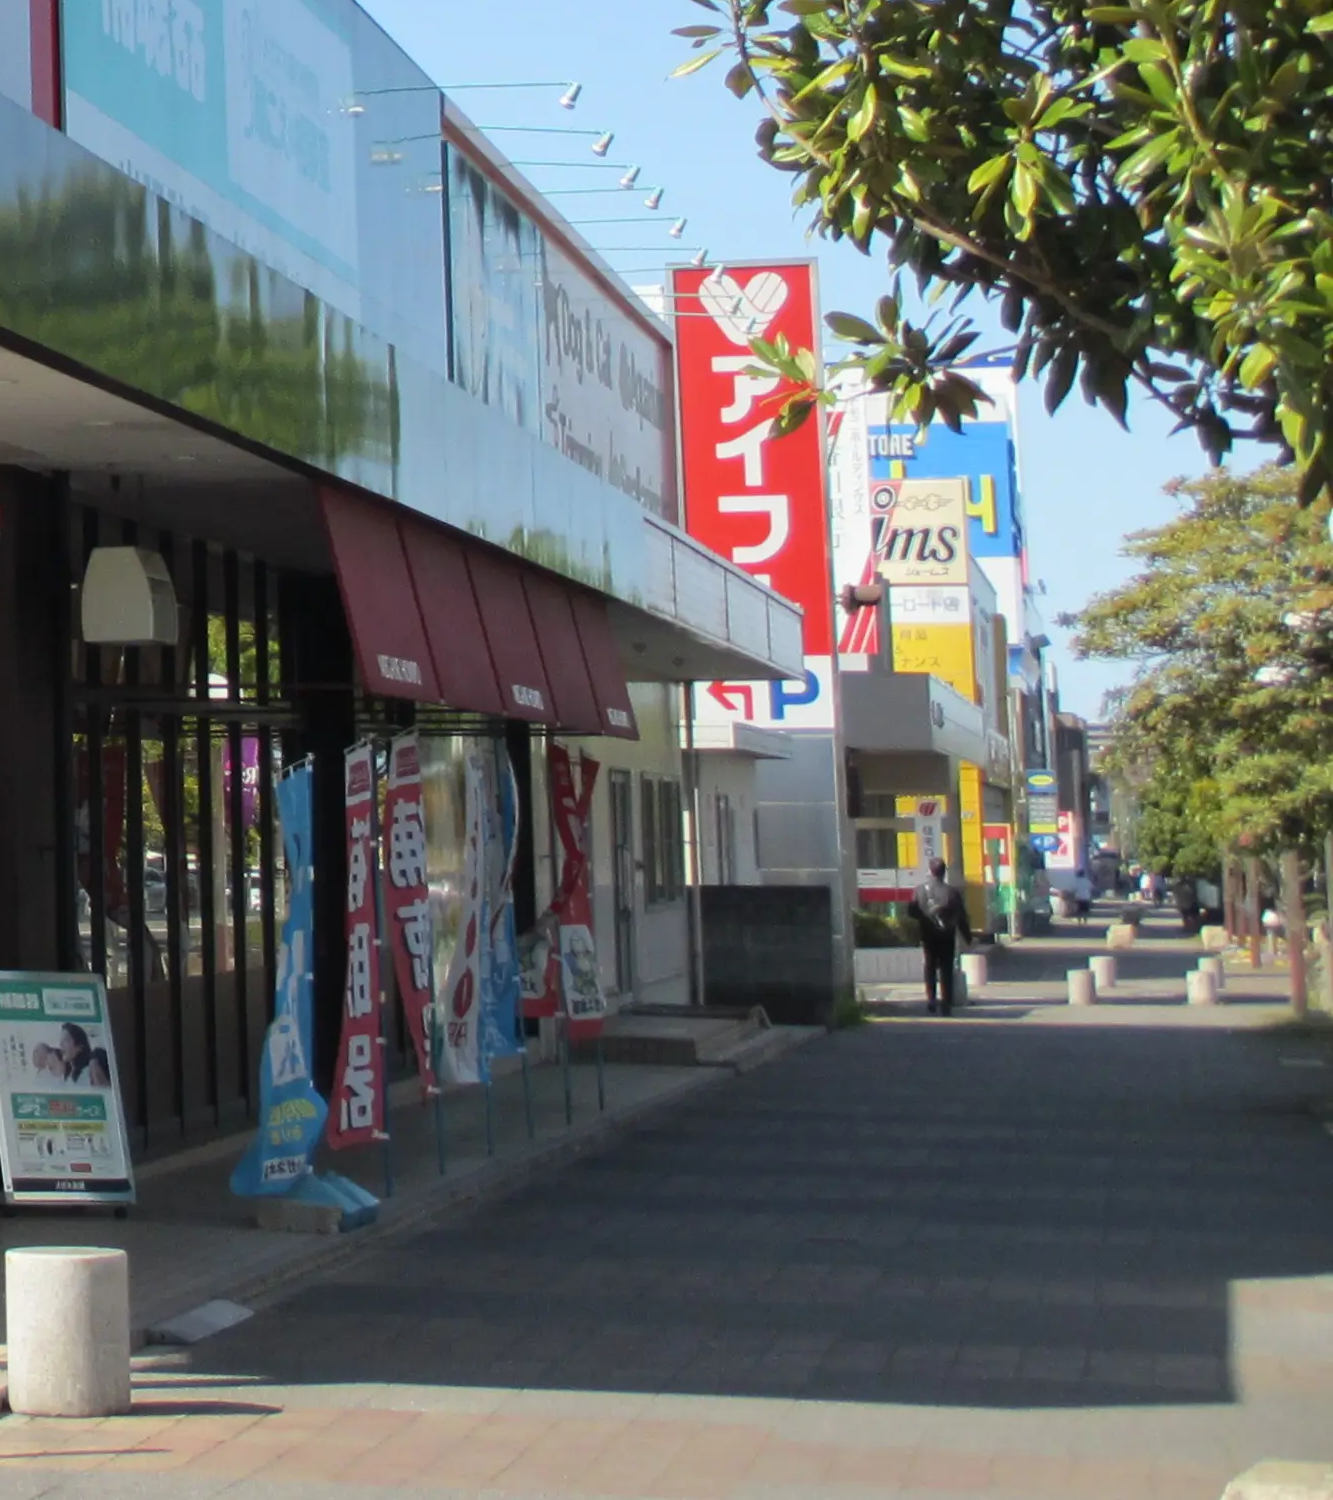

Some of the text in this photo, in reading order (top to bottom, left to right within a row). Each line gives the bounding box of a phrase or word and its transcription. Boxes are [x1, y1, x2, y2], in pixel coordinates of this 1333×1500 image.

[710, 355, 790, 587] アイフ
[769, 668, 821, 720] P
